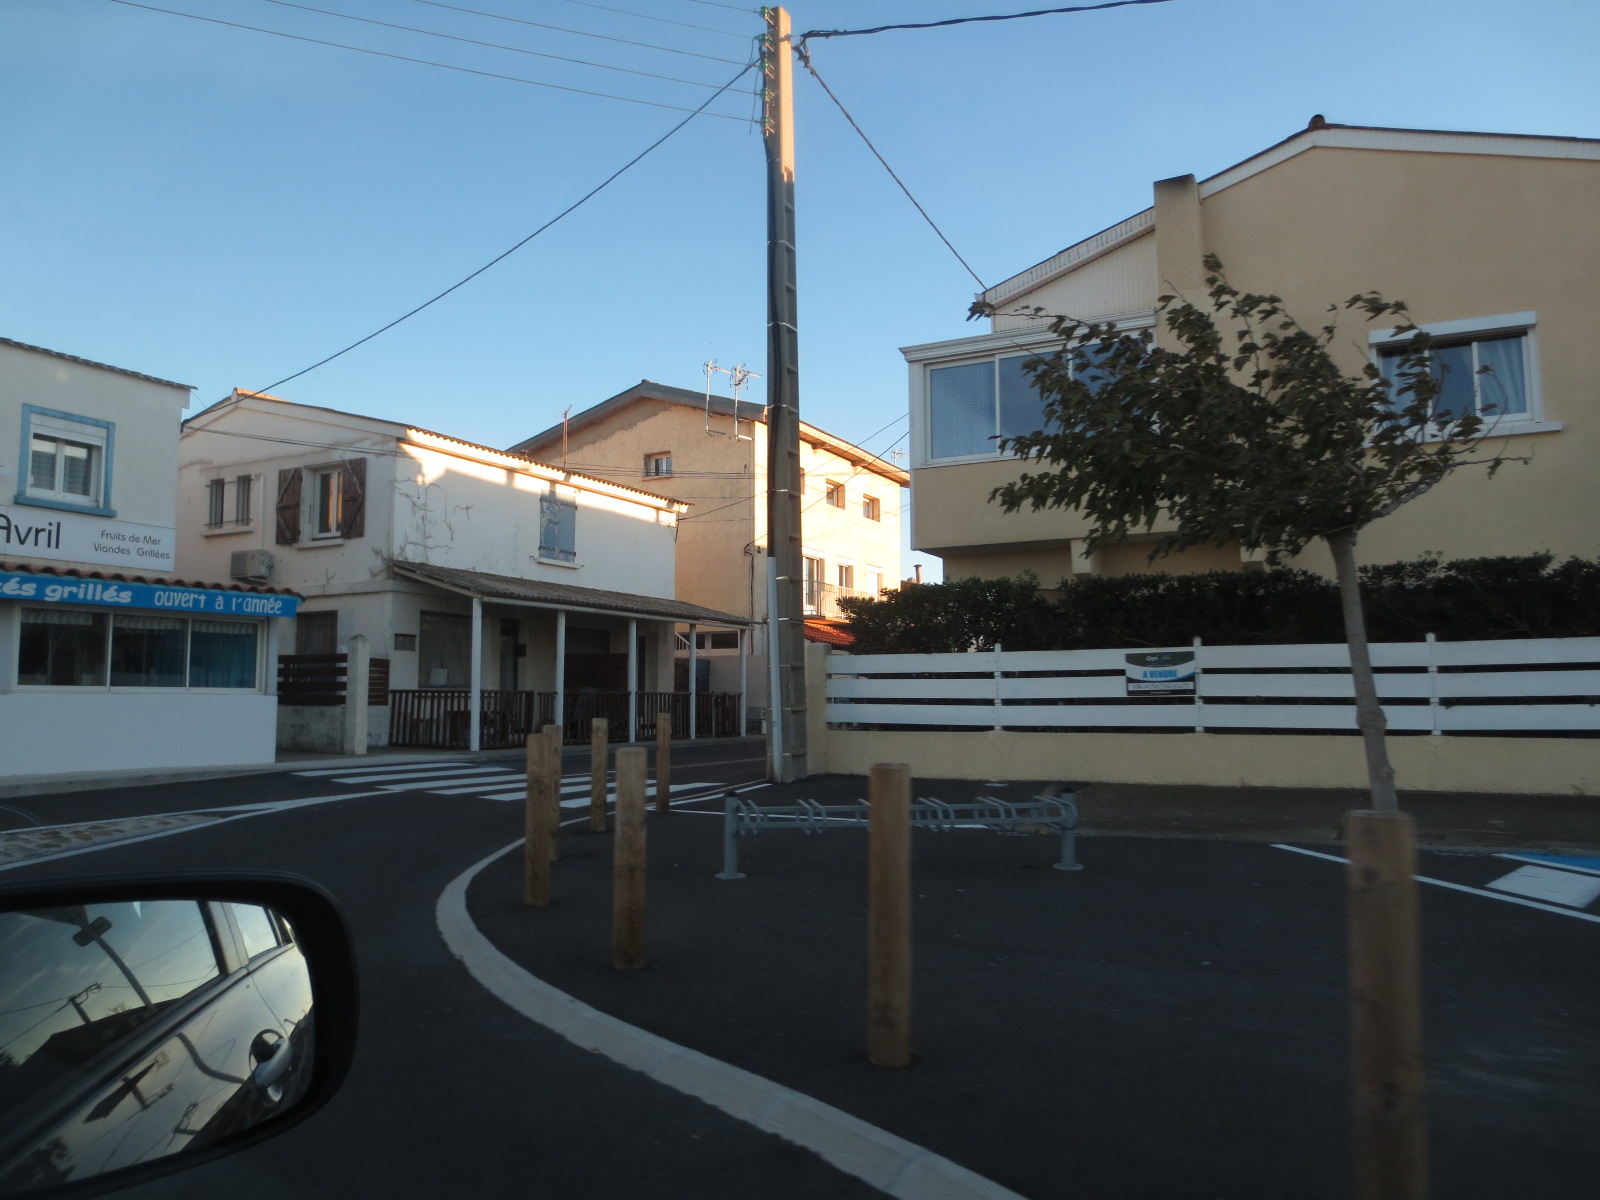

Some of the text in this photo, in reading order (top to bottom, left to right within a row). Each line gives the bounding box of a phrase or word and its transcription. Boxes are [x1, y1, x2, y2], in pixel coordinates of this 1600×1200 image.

[0, 513, 61, 549] Avril
[101, 530, 161, 546] Fruits de Mer
[94, 543, 170, 559] Viandes Grillées
[0, 577, 37, 596] és
[44, 583, 132, 603] grillés
[215, 595, 224, 610] à
[232, 598, 282, 614] l'année
[1142, 669, 1178, 679] A VENDRE
